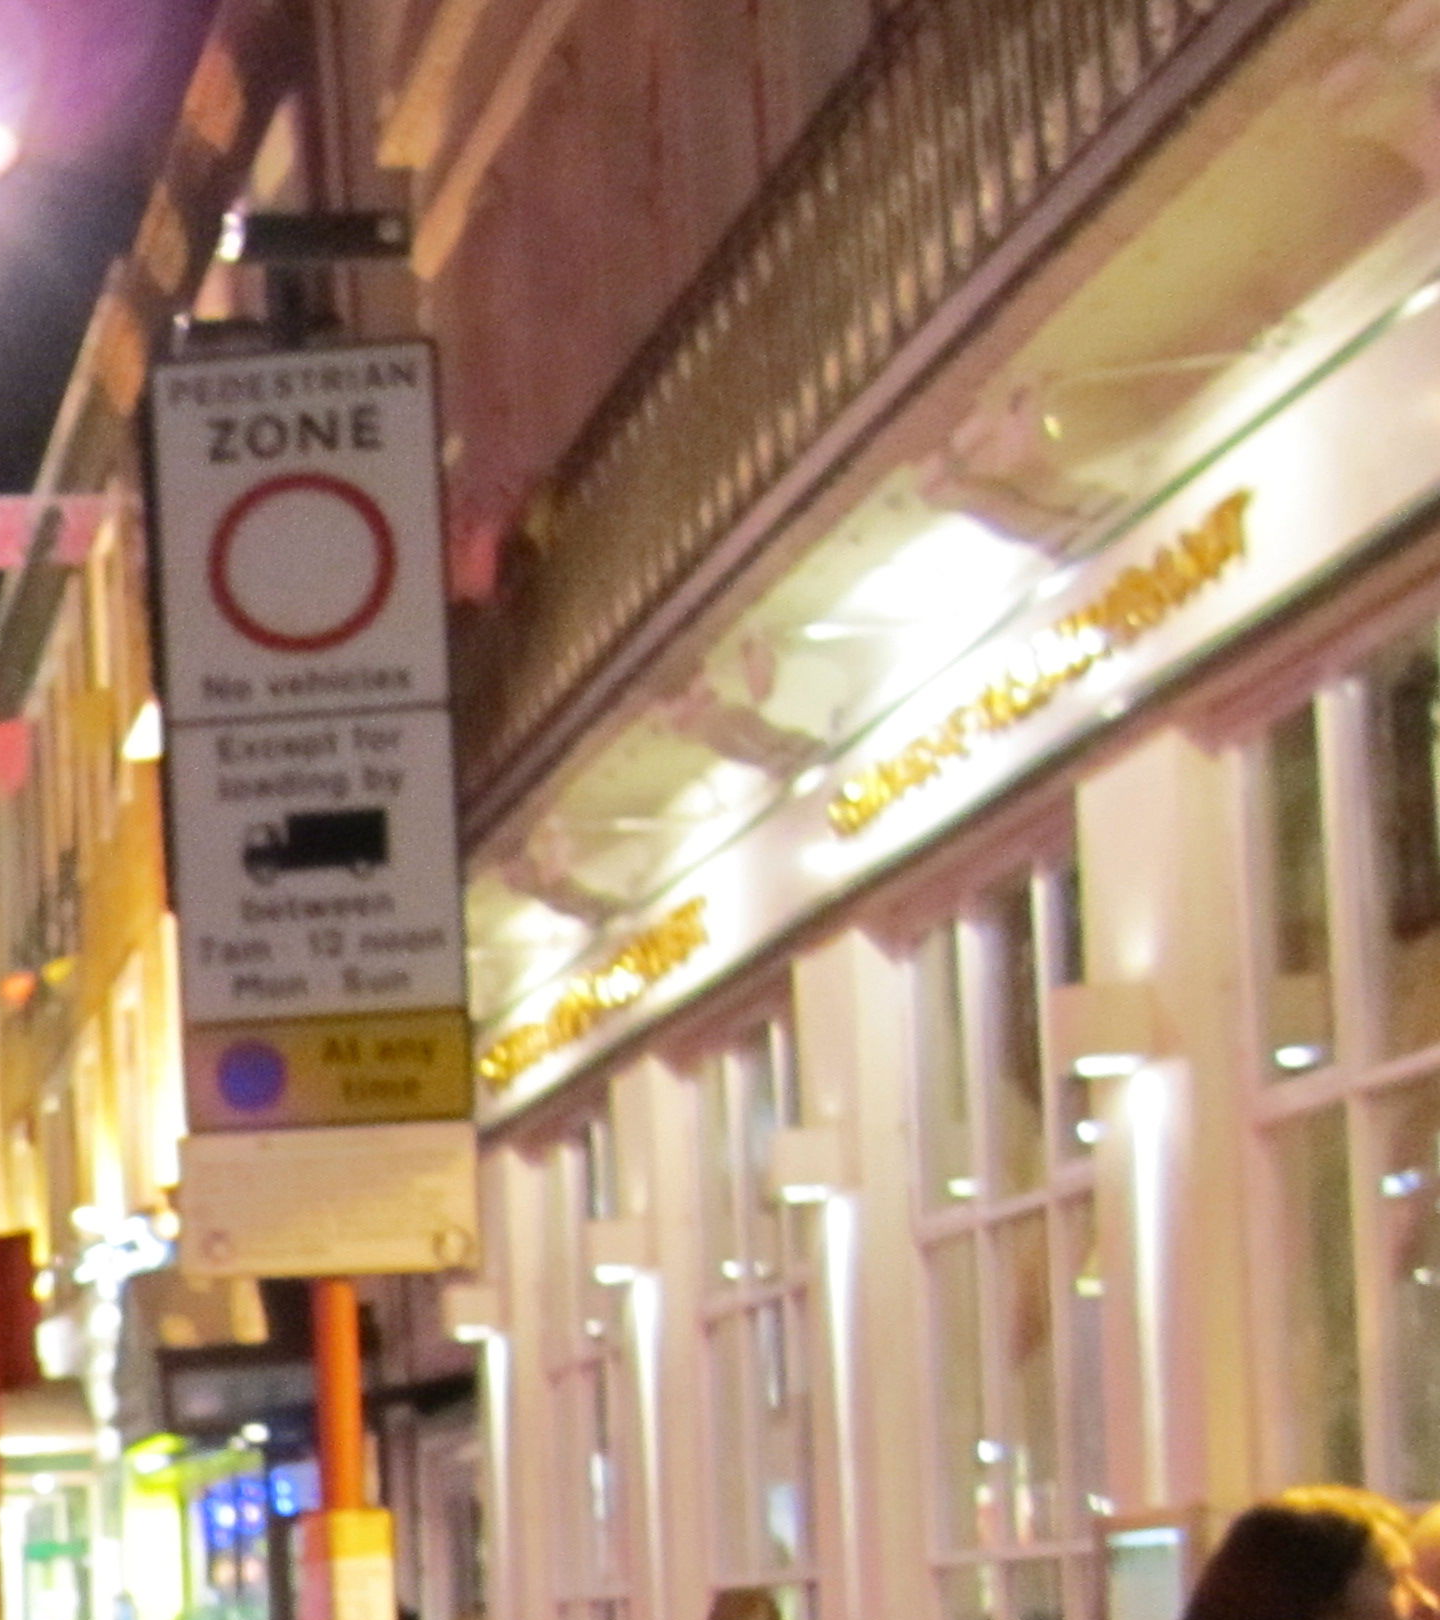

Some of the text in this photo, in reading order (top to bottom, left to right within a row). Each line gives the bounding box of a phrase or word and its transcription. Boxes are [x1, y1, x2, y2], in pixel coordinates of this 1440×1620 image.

[168, 360, 419, 406] PEDESTRIAN
[207, 404, 384, 464] ZONE
[201, 666, 412, 701] No vehicles
[353, 726, 402, 752] for
[362, 765, 404, 796] by
[322, 1035, 437, 1064] At any
[342, 1076, 420, 1102] time
